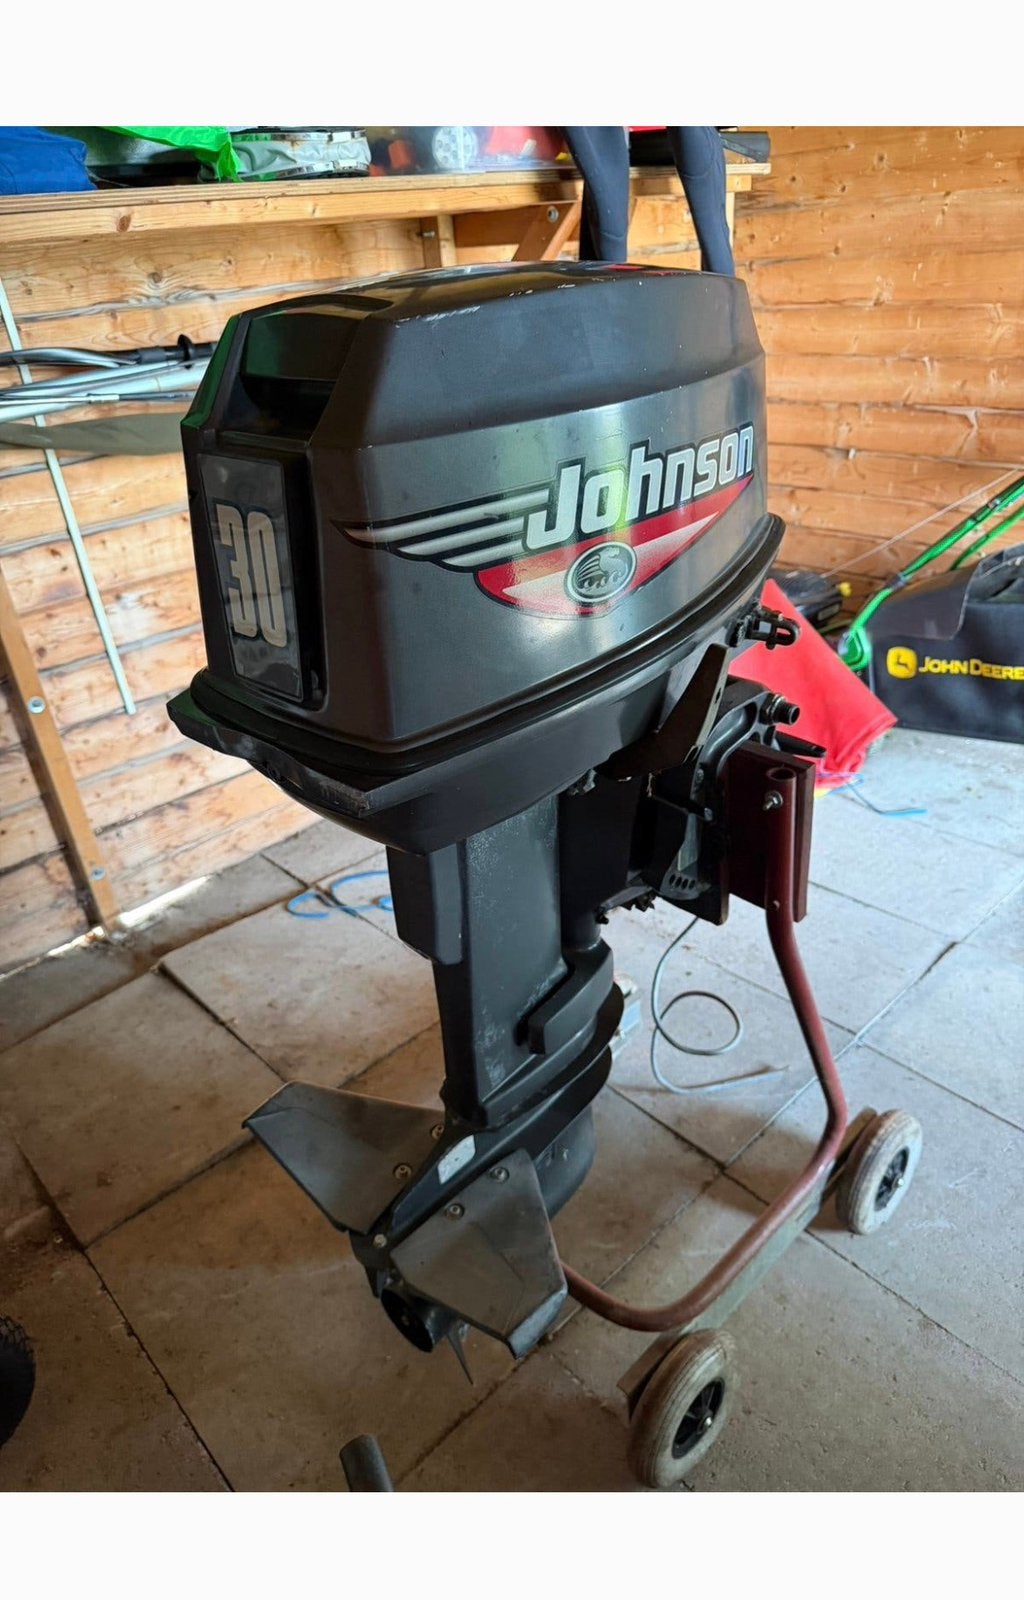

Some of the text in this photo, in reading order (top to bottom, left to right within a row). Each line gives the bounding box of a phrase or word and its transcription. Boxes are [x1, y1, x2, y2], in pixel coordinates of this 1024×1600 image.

[525, 425, 754, 550] Johnson
[215, 504, 287, 648] 30
[919, 656, 1024, 680] JOHN DEERE
